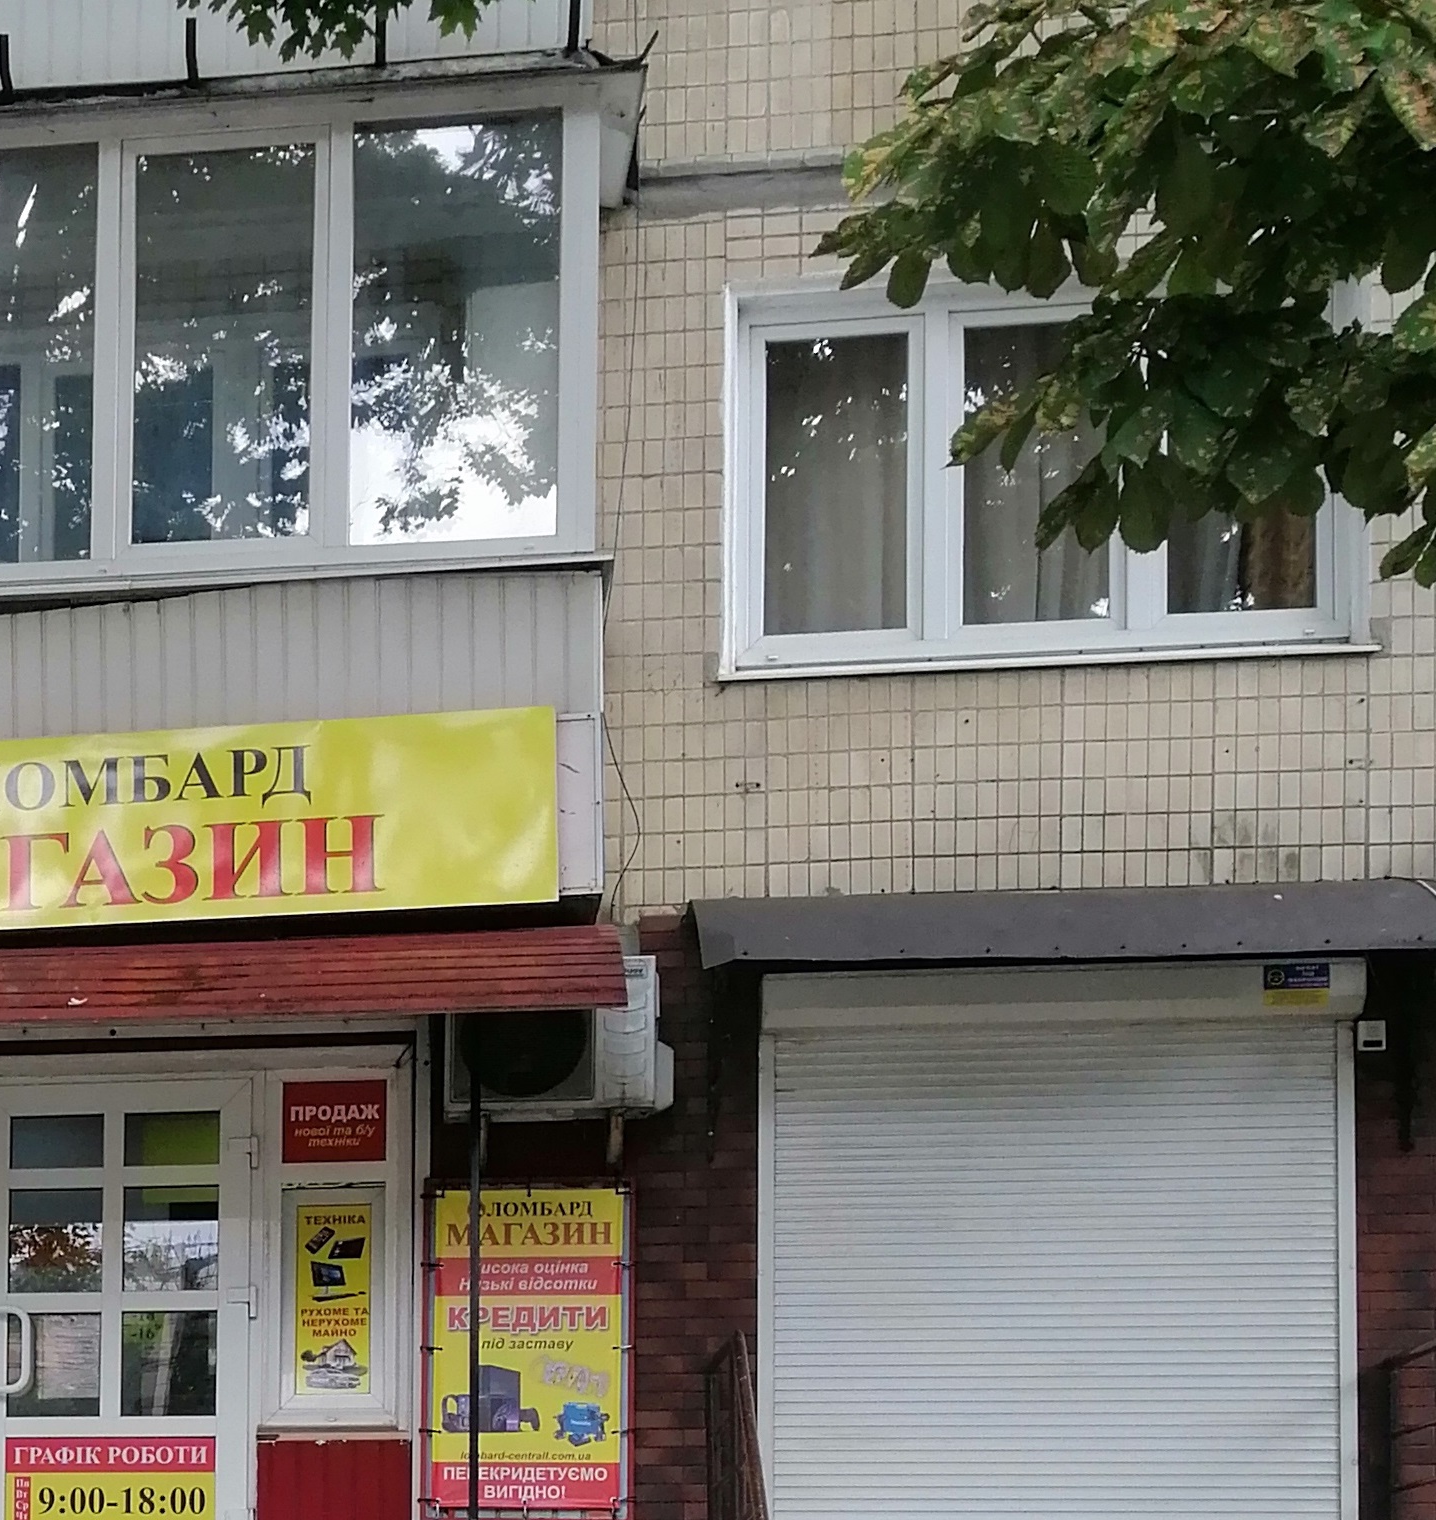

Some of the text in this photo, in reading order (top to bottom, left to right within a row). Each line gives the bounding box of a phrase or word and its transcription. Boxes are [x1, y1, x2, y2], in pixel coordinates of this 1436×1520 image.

[290, 1103, 380, 1123] ПРОДАЖ
[333, 1126, 352, 1136] та
[487, 1201, 593, 1217] ЛОМБАРД
[304, 1214, 366, 1225] ТЕХНІКА
[446, 1221, 613, 1246] МАГАЗИН
[470, 1261, 589, 1276] исока оцінка
[459, 1277, 598, 1291] Нзькі відсотки
[301, 1307, 369, 1317] РУХОМЕ ТА
[302, 1318, 367, 1327] НЕРУХОМЕ
[481, 1338, 574, 1352] під заставу
[13, 1445, 208, 1465] ГРАФІК РОБОТИ
[460, 1451, 592, 1461] lobard-centrall.com.ua
[443, 1467, 608, 1482] ПЕЕКРИДЕТУЄМО
[484, 1485, 566, 1500] ВИГІДНО!
[38, 1486, 206, 1515] 9:00-18:00
